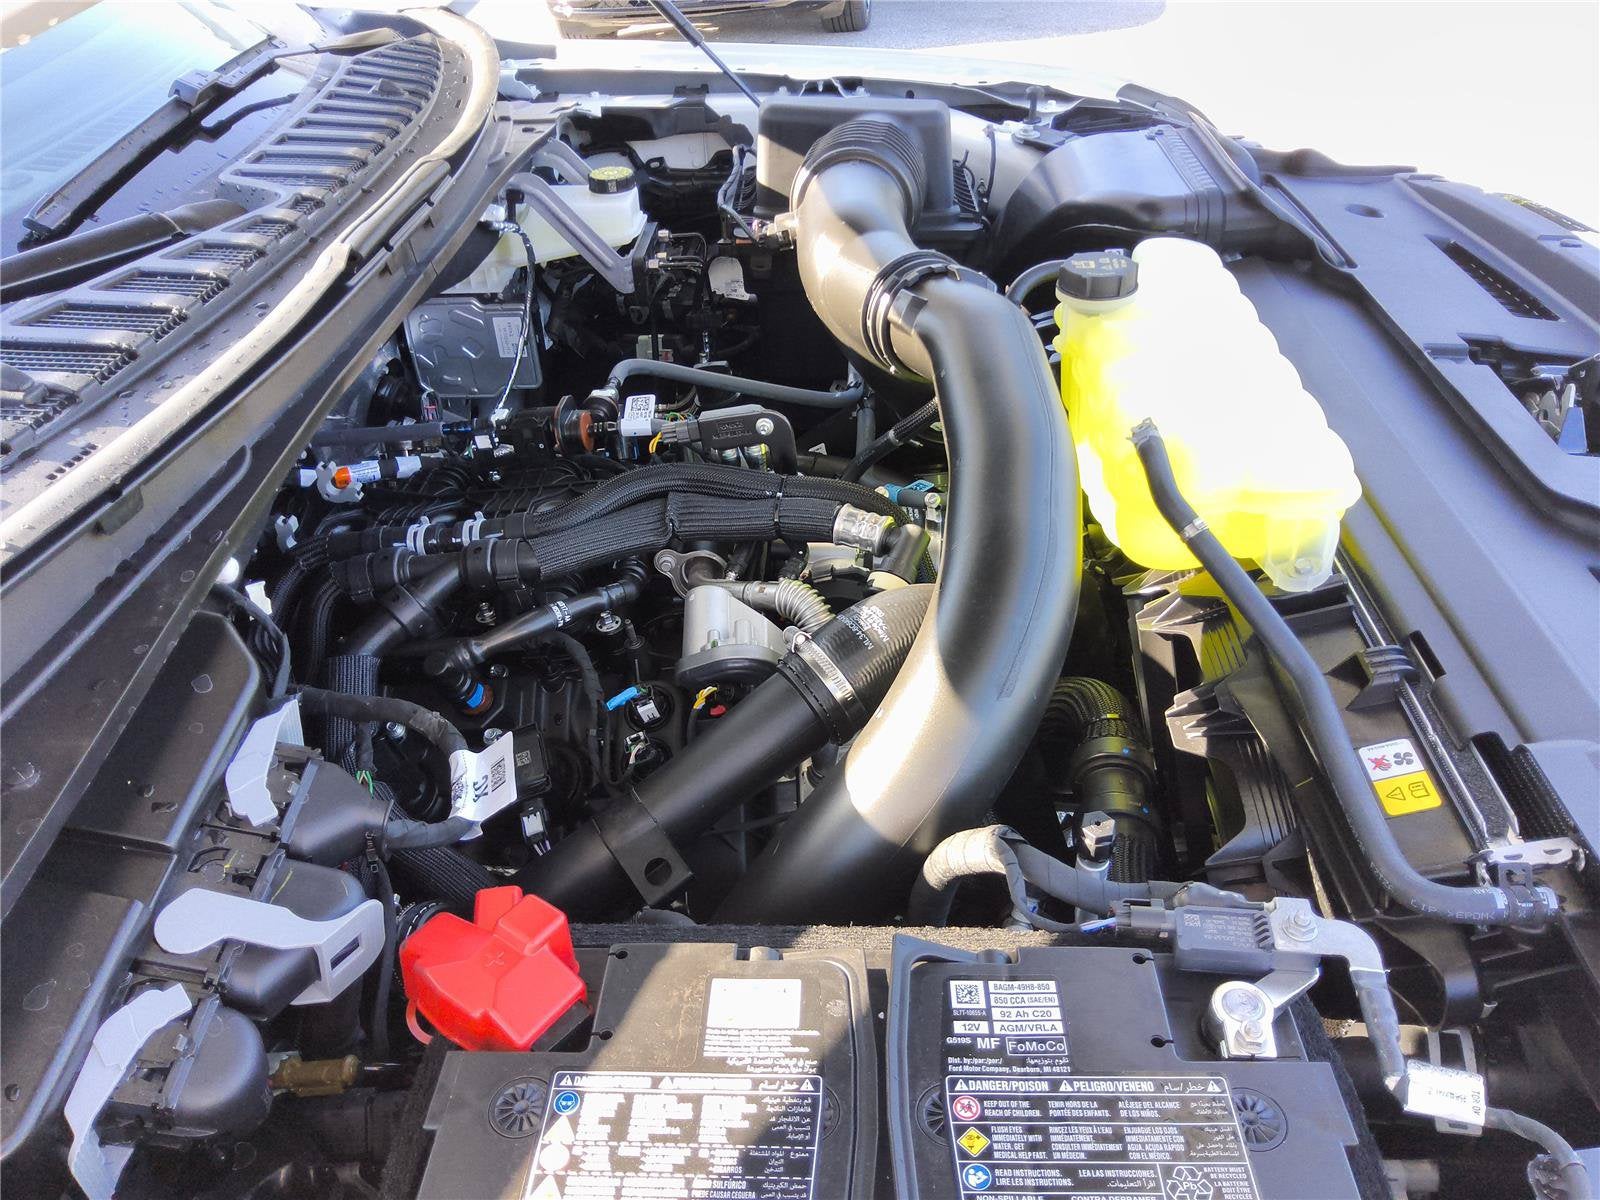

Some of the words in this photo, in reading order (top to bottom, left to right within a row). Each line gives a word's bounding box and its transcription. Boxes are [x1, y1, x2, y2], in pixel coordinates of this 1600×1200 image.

[1027, 996, 1056, 1004] (SAE/EN)
[1016, 1010, 1029, 1018] Ah
[1032, 1010, 1052, 1018] C20
[1000, 1024, 1058, 1032] AGM/VRLA
[976, 1038, 1000, 1049] MF
[1008, 1041, 1065, 1052] FoMoCo
[968, 1080, 1049, 1091] DANGER/POISON
[1073, 1081, 1155, 1092] PELIGRO/VENENO
[1049, 1108, 1071, 1116] PORTÉE
[991, 1126, 1008, 1134] FLUSH
[1009, 1126, 1022, 1134] EYES
[1068, 1126, 1078, 1134] LES
[992, 1134, 1028, 1142] IMMEDIATELY
[1028, 1134, 1042, 1142] WITH
[1014, 1142, 1025, 1150] GET
[994, 1151, 1018, 1159] MEDICAL
[1032, 1152, 1048, 1160] FAST.
[995, 1168, 1012, 1176] READ
[1013, 1169, 1062, 1177] INSTRUCTIONS.
[1079, 1170, 1091, 1178] LEA
[1092, 1170, 1104, 1178] LAS
[1105, 1170, 1157, 1178] INSTRUCCIONES.
[712, 1178, 747, 1189] SULFÚRICO
[996, 1178, 1012, 1186] LIRE
[1012, 1178, 1024, 1186] LES
[1025, 1178, 1074, 1186] INSTRUCTIONS.
[1183, 1182, 1198, 1190] Pb
[710, 1190, 731, 1198] CAUSAR
[731, 1191, 756, 1199] CEGUERA
